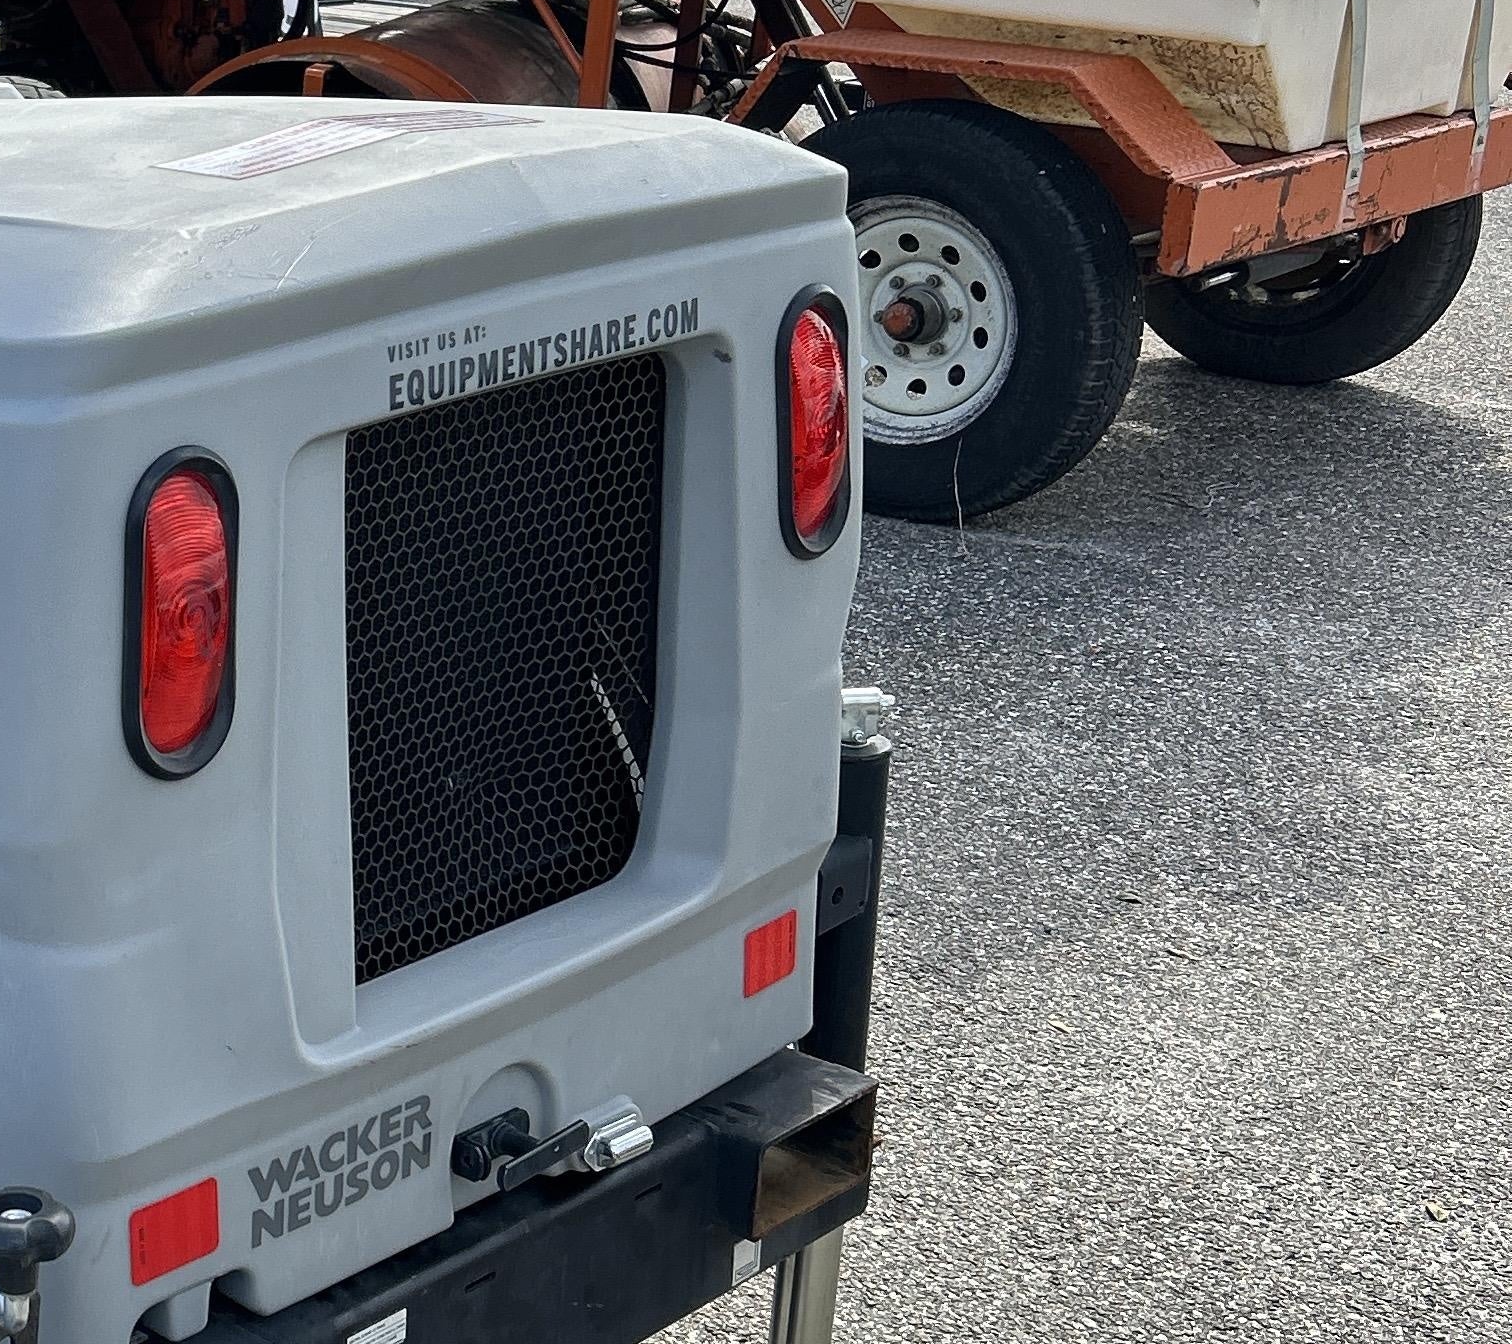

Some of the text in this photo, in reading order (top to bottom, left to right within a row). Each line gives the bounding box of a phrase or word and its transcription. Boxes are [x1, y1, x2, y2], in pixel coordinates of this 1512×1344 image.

[387, 324, 487, 364] VISIT US AT:
[388, 297, 700, 412] EQUIPMENTSHARE.COM
[247, 1094, 433, 1203] WACKER
[251, 1131, 433, 1248] NEUSON
